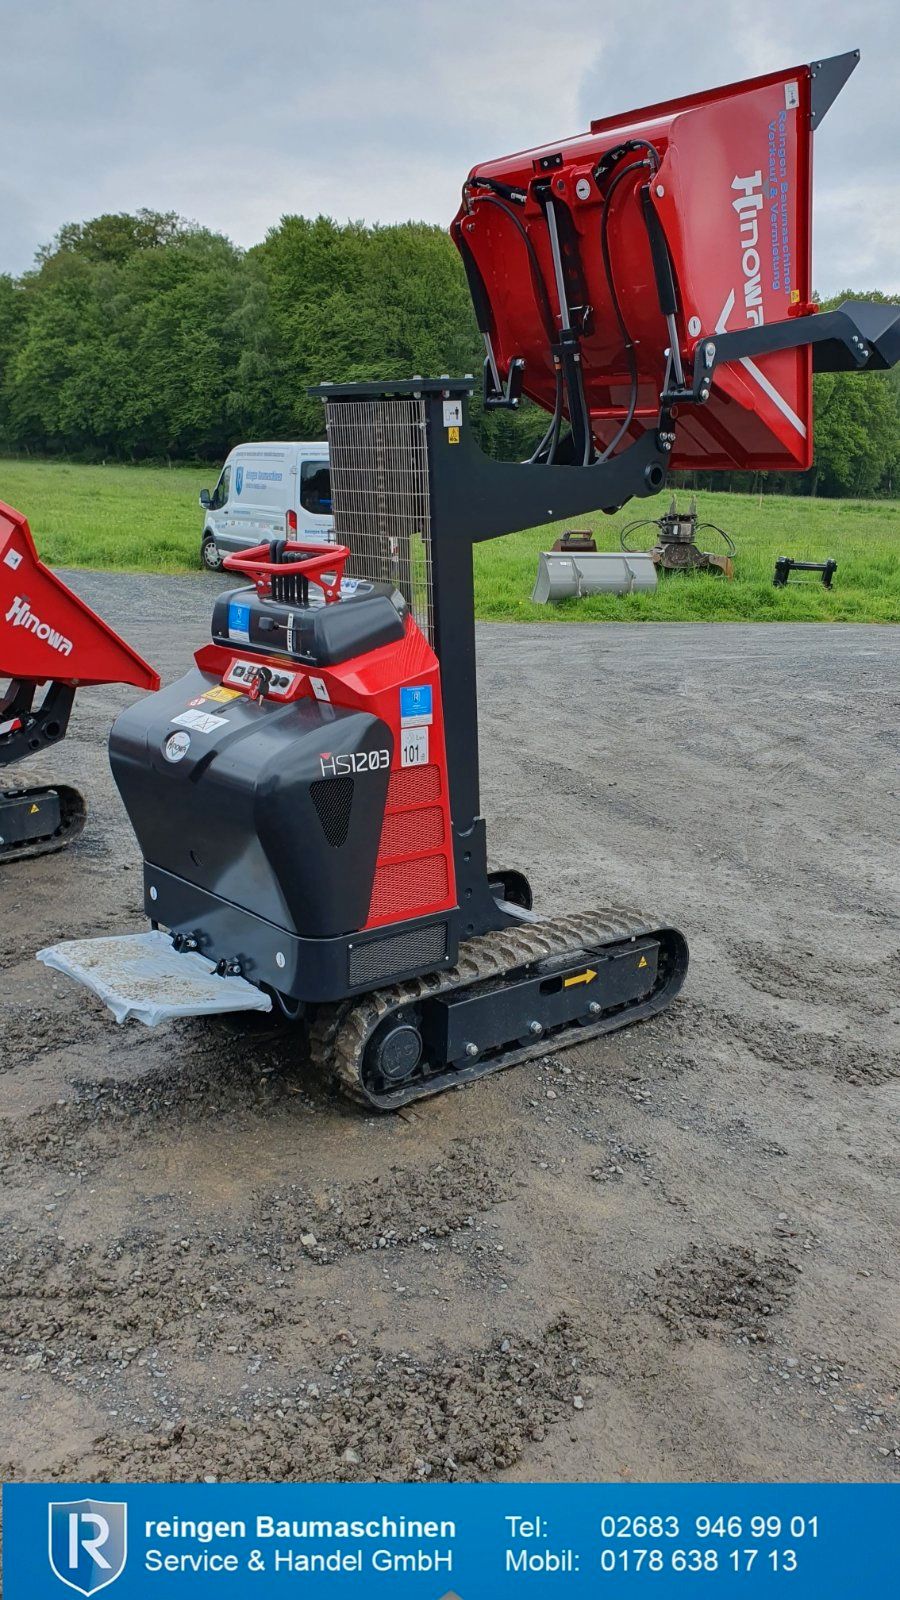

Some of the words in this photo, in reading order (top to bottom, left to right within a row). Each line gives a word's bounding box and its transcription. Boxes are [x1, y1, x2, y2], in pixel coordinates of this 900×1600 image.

[768, 121, 778, 182] Verkauf
[771, 202, 780, 290] Vermietung
[320, 749, 390, 777] HS1203
[404, 744, 419, 763] 101
